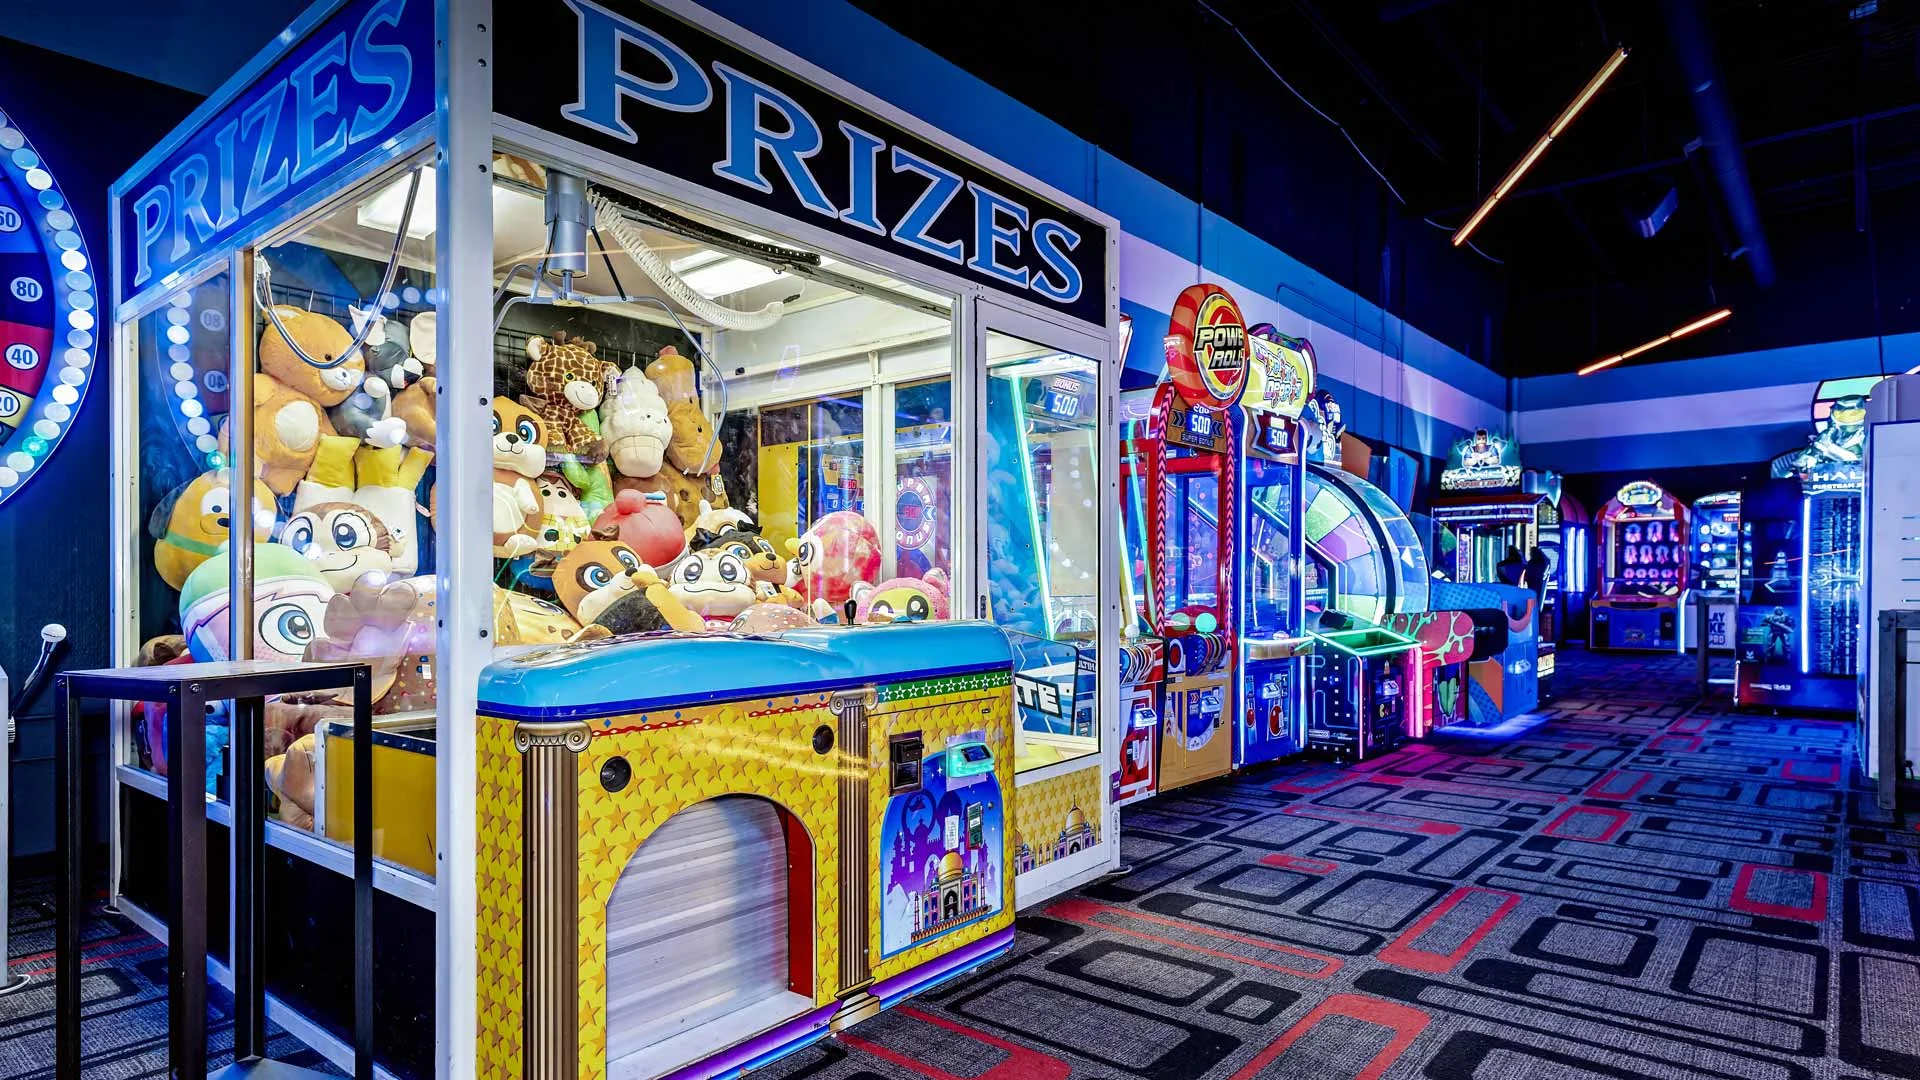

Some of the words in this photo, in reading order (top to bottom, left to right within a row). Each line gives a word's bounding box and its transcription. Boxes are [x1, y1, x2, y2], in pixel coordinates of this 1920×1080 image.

[133, 0, 413, 288] PRIZES
[560, 0, 1083, 304] PRIZES
[16, 280, 38, 298] 80
[1197, 327, 1243, 349] POWE
[11, 348, 33, 366] 40
[1053, 377, 1081, 392] BONUS
[1052, 394, 1079, 417] 500
[1191, 414, 1211, 435] 500
[1271, 432, 1289, 448] 500
